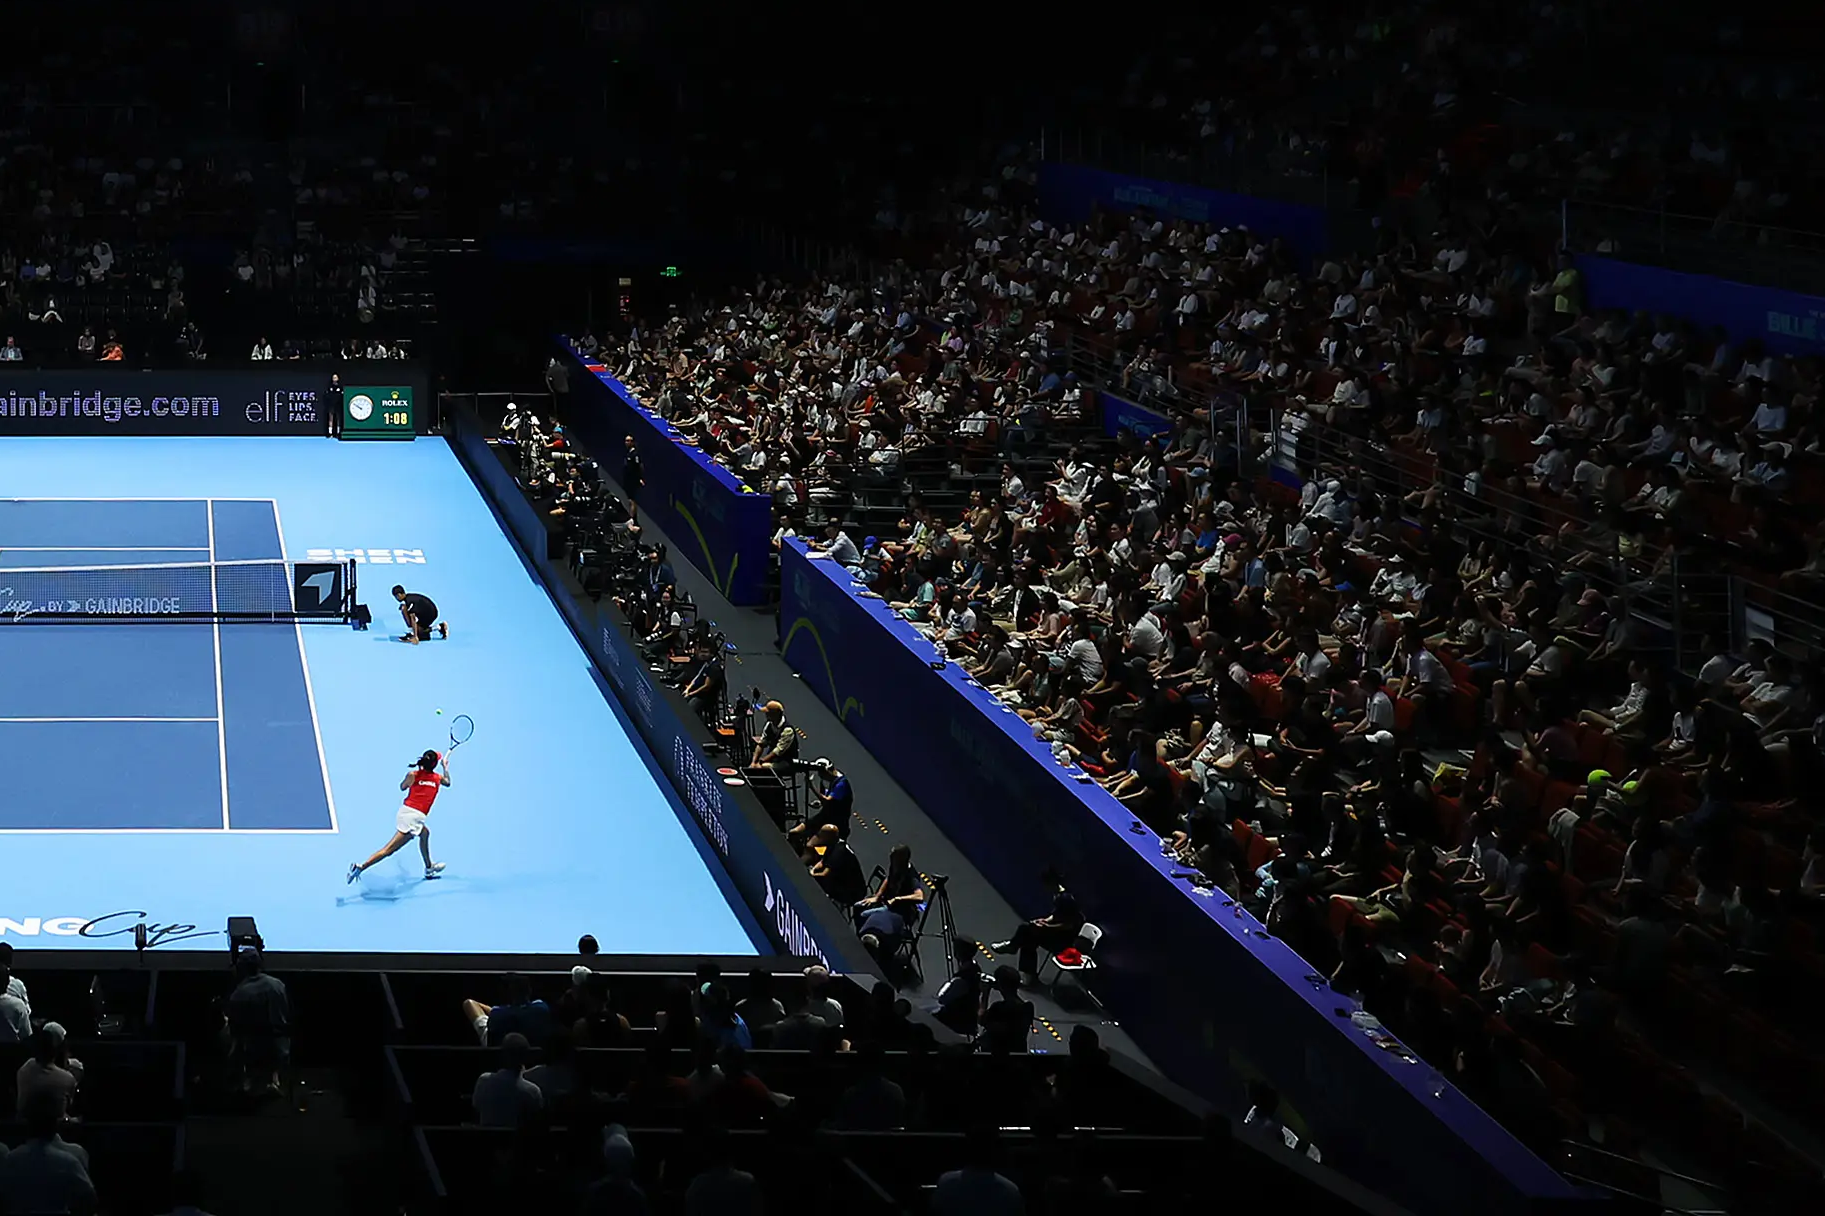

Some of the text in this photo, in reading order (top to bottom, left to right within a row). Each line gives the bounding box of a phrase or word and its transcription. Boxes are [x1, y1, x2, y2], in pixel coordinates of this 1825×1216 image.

[288, 392, 318, 402] EYES.
[288, 402, 315, 412] LIPS.
[288, 412, 319, 422] FACE.
[383, 412, 408, 425] 1:08
[48, 600, 64, 612] BY
[85, 597, 180, 614] GAINBRIDGE
